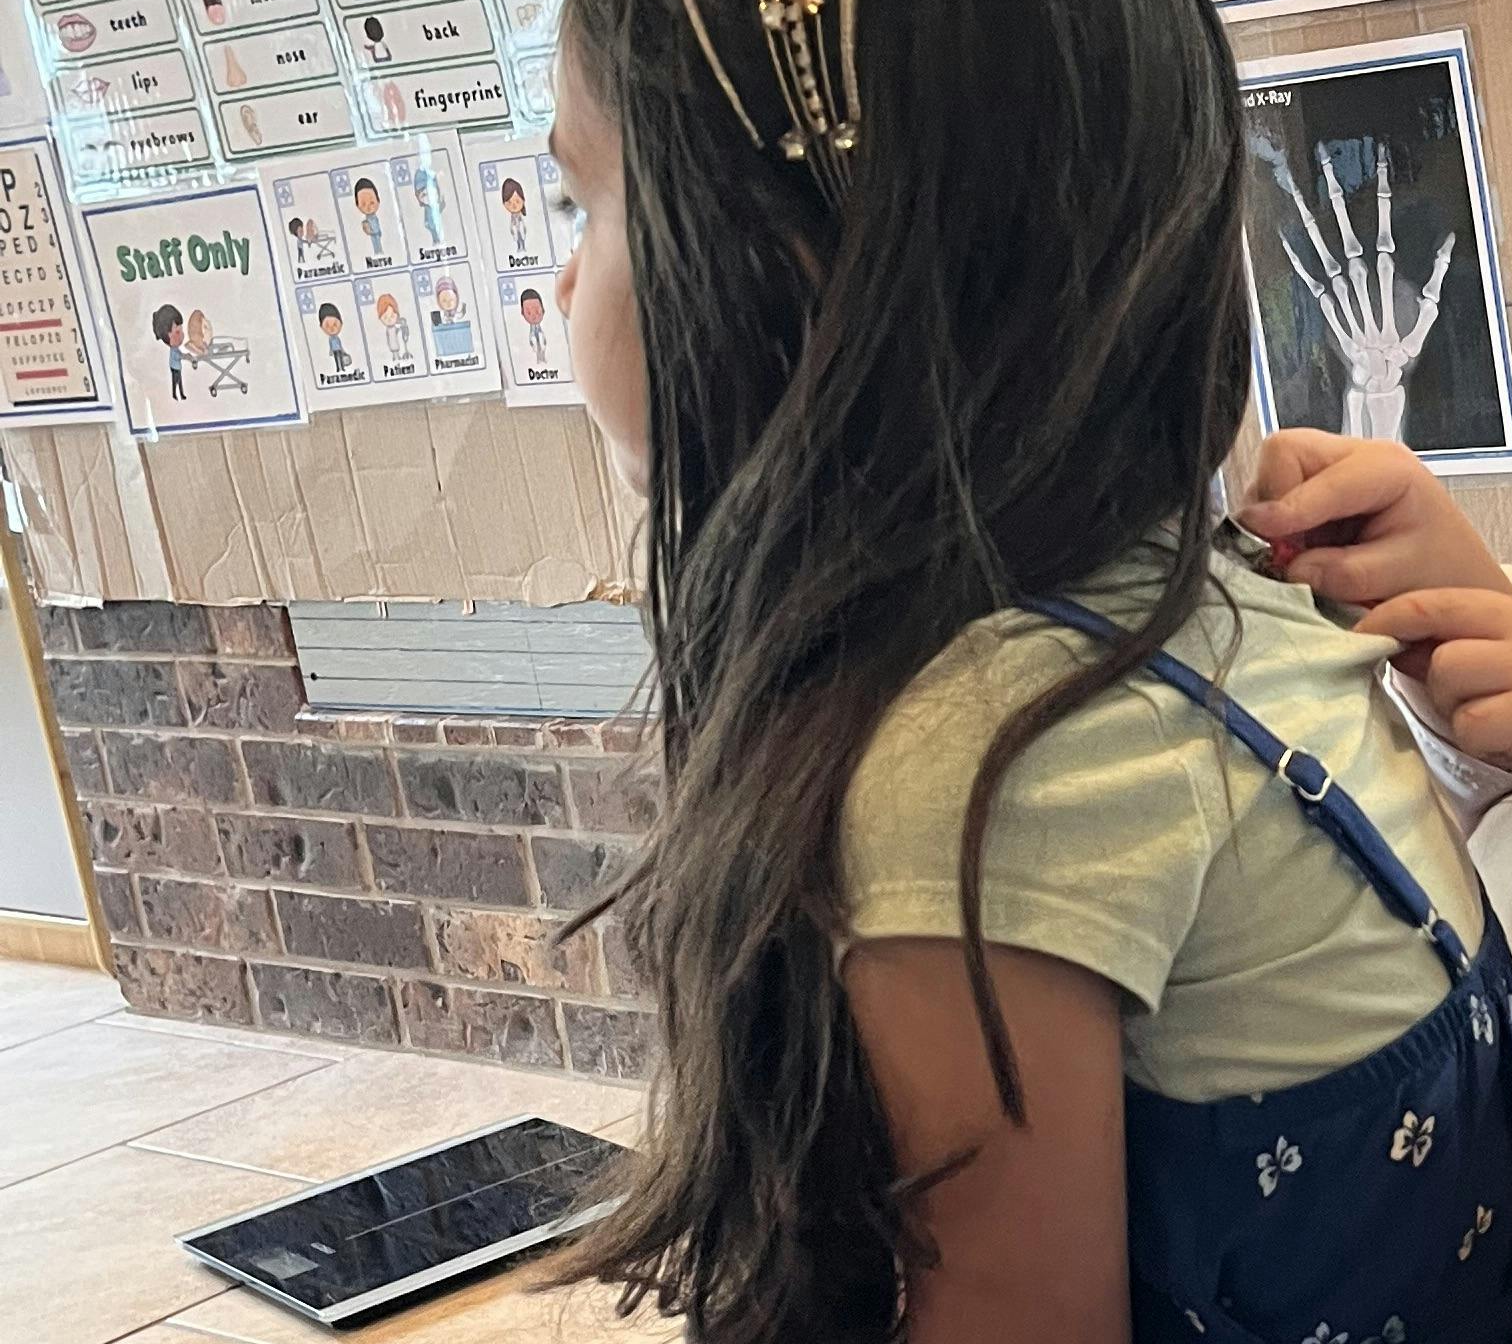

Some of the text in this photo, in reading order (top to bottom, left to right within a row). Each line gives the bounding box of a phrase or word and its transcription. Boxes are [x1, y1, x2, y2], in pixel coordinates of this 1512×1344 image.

[110, 10, 147, 32] teeth
[423, 20, 460, 42] back
[277, 47, 306, 66] nose
[132, 72, 159, 94] lips
[415, 81, 503, 112] fingerprint
[1256, 90, 1292, 106] X-Ray
[298, 110, 318, 126] ear
[130, 129, 196, 153] eyebrows
[0, 168, 43, 202] P 2
[41, 207, 49, 224] 3
[116, 230, 250, 283] Staff Only
[366, 256, 393, 269] Nurse
[508, 255, 538, 268] Doctor
[56, 264, 64, 281] 5
[297, 262, 345, 280] Paramedic
[63, 293, 72, 311] 6
[71, 328, 79, 344] 7
[76, 347, 85, 364] 8
[320, 368, 366, 386] Paramedic
[383, 362, 415, 378] Patient
[528, 368, 559, 381] Doctor
